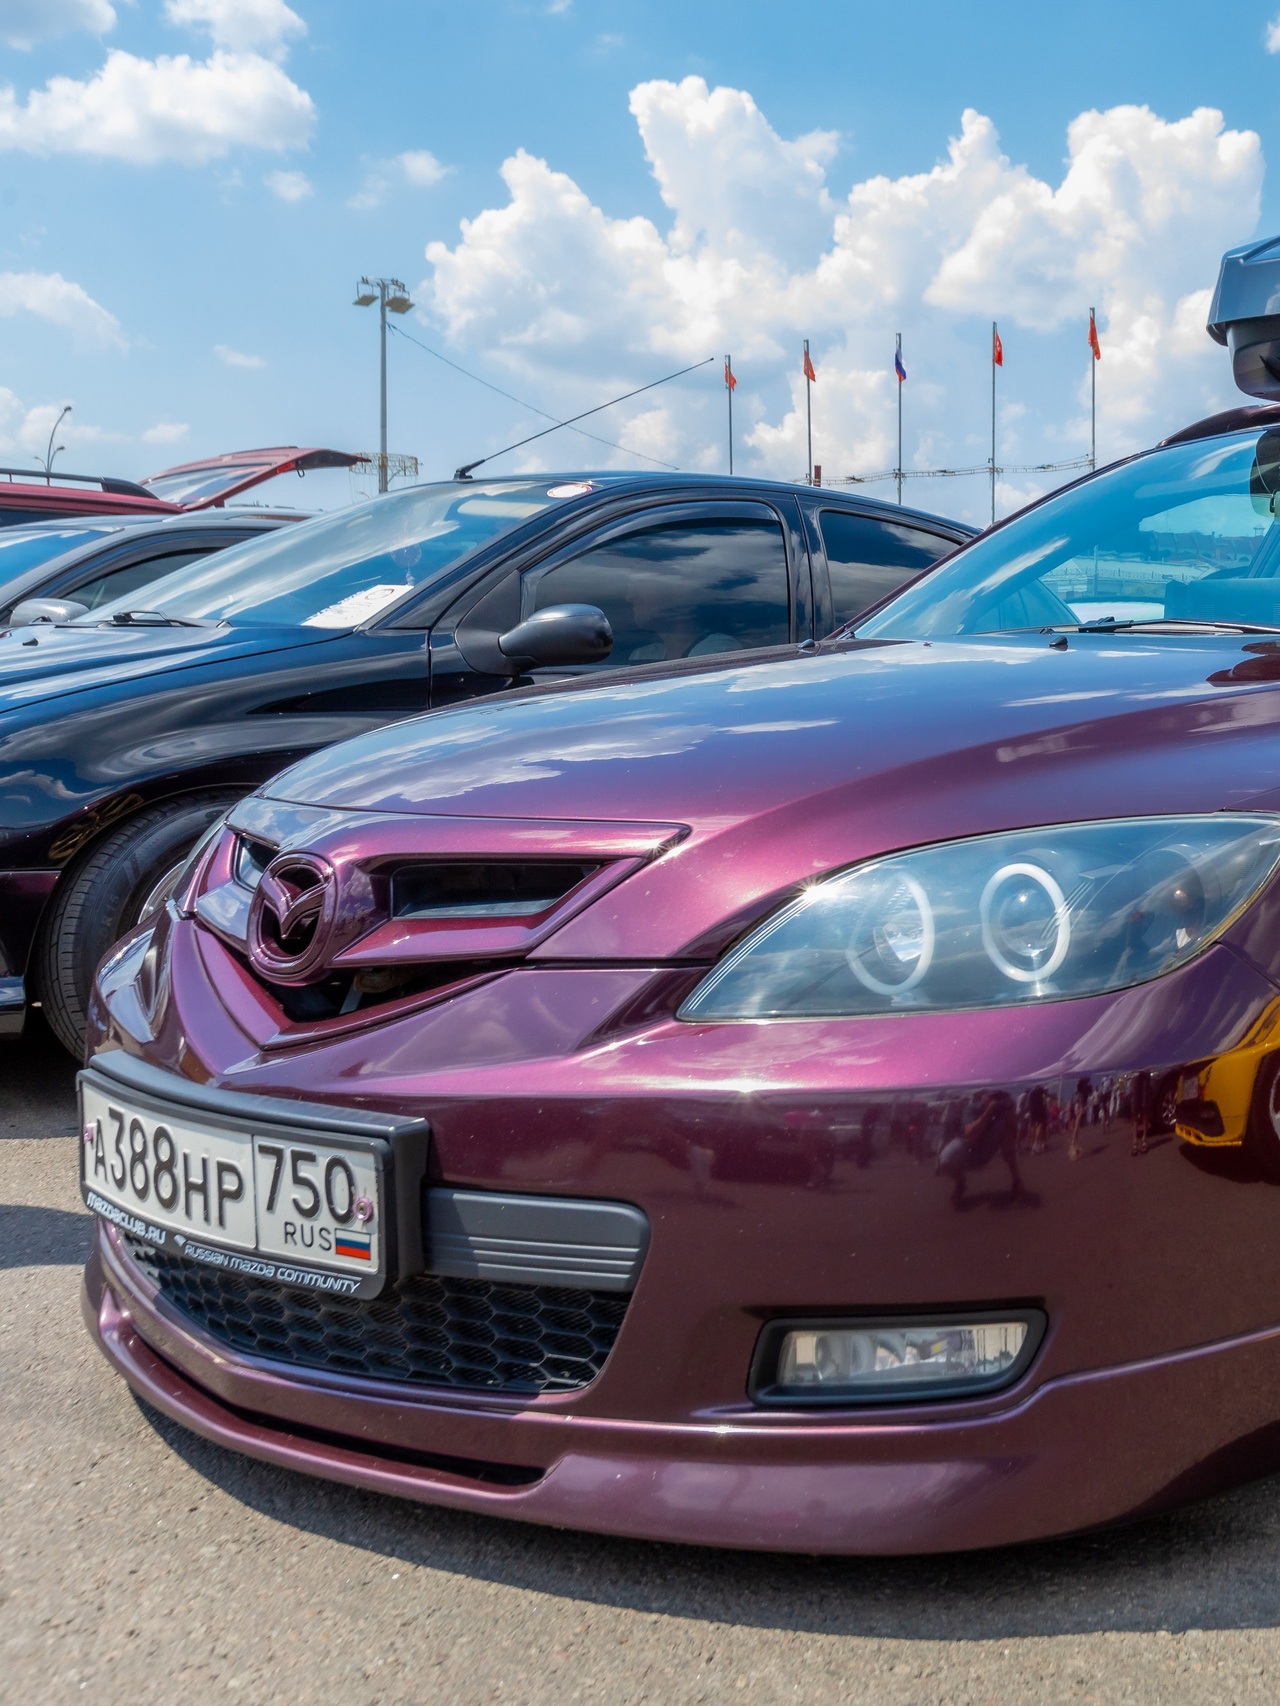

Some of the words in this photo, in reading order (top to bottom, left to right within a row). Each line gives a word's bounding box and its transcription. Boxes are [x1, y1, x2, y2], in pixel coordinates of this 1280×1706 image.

[93, 1106, 244, 1227] A388HP
[258, 1144, 355, 1225] 750
[284, 1222, 332, 1251] RUS
